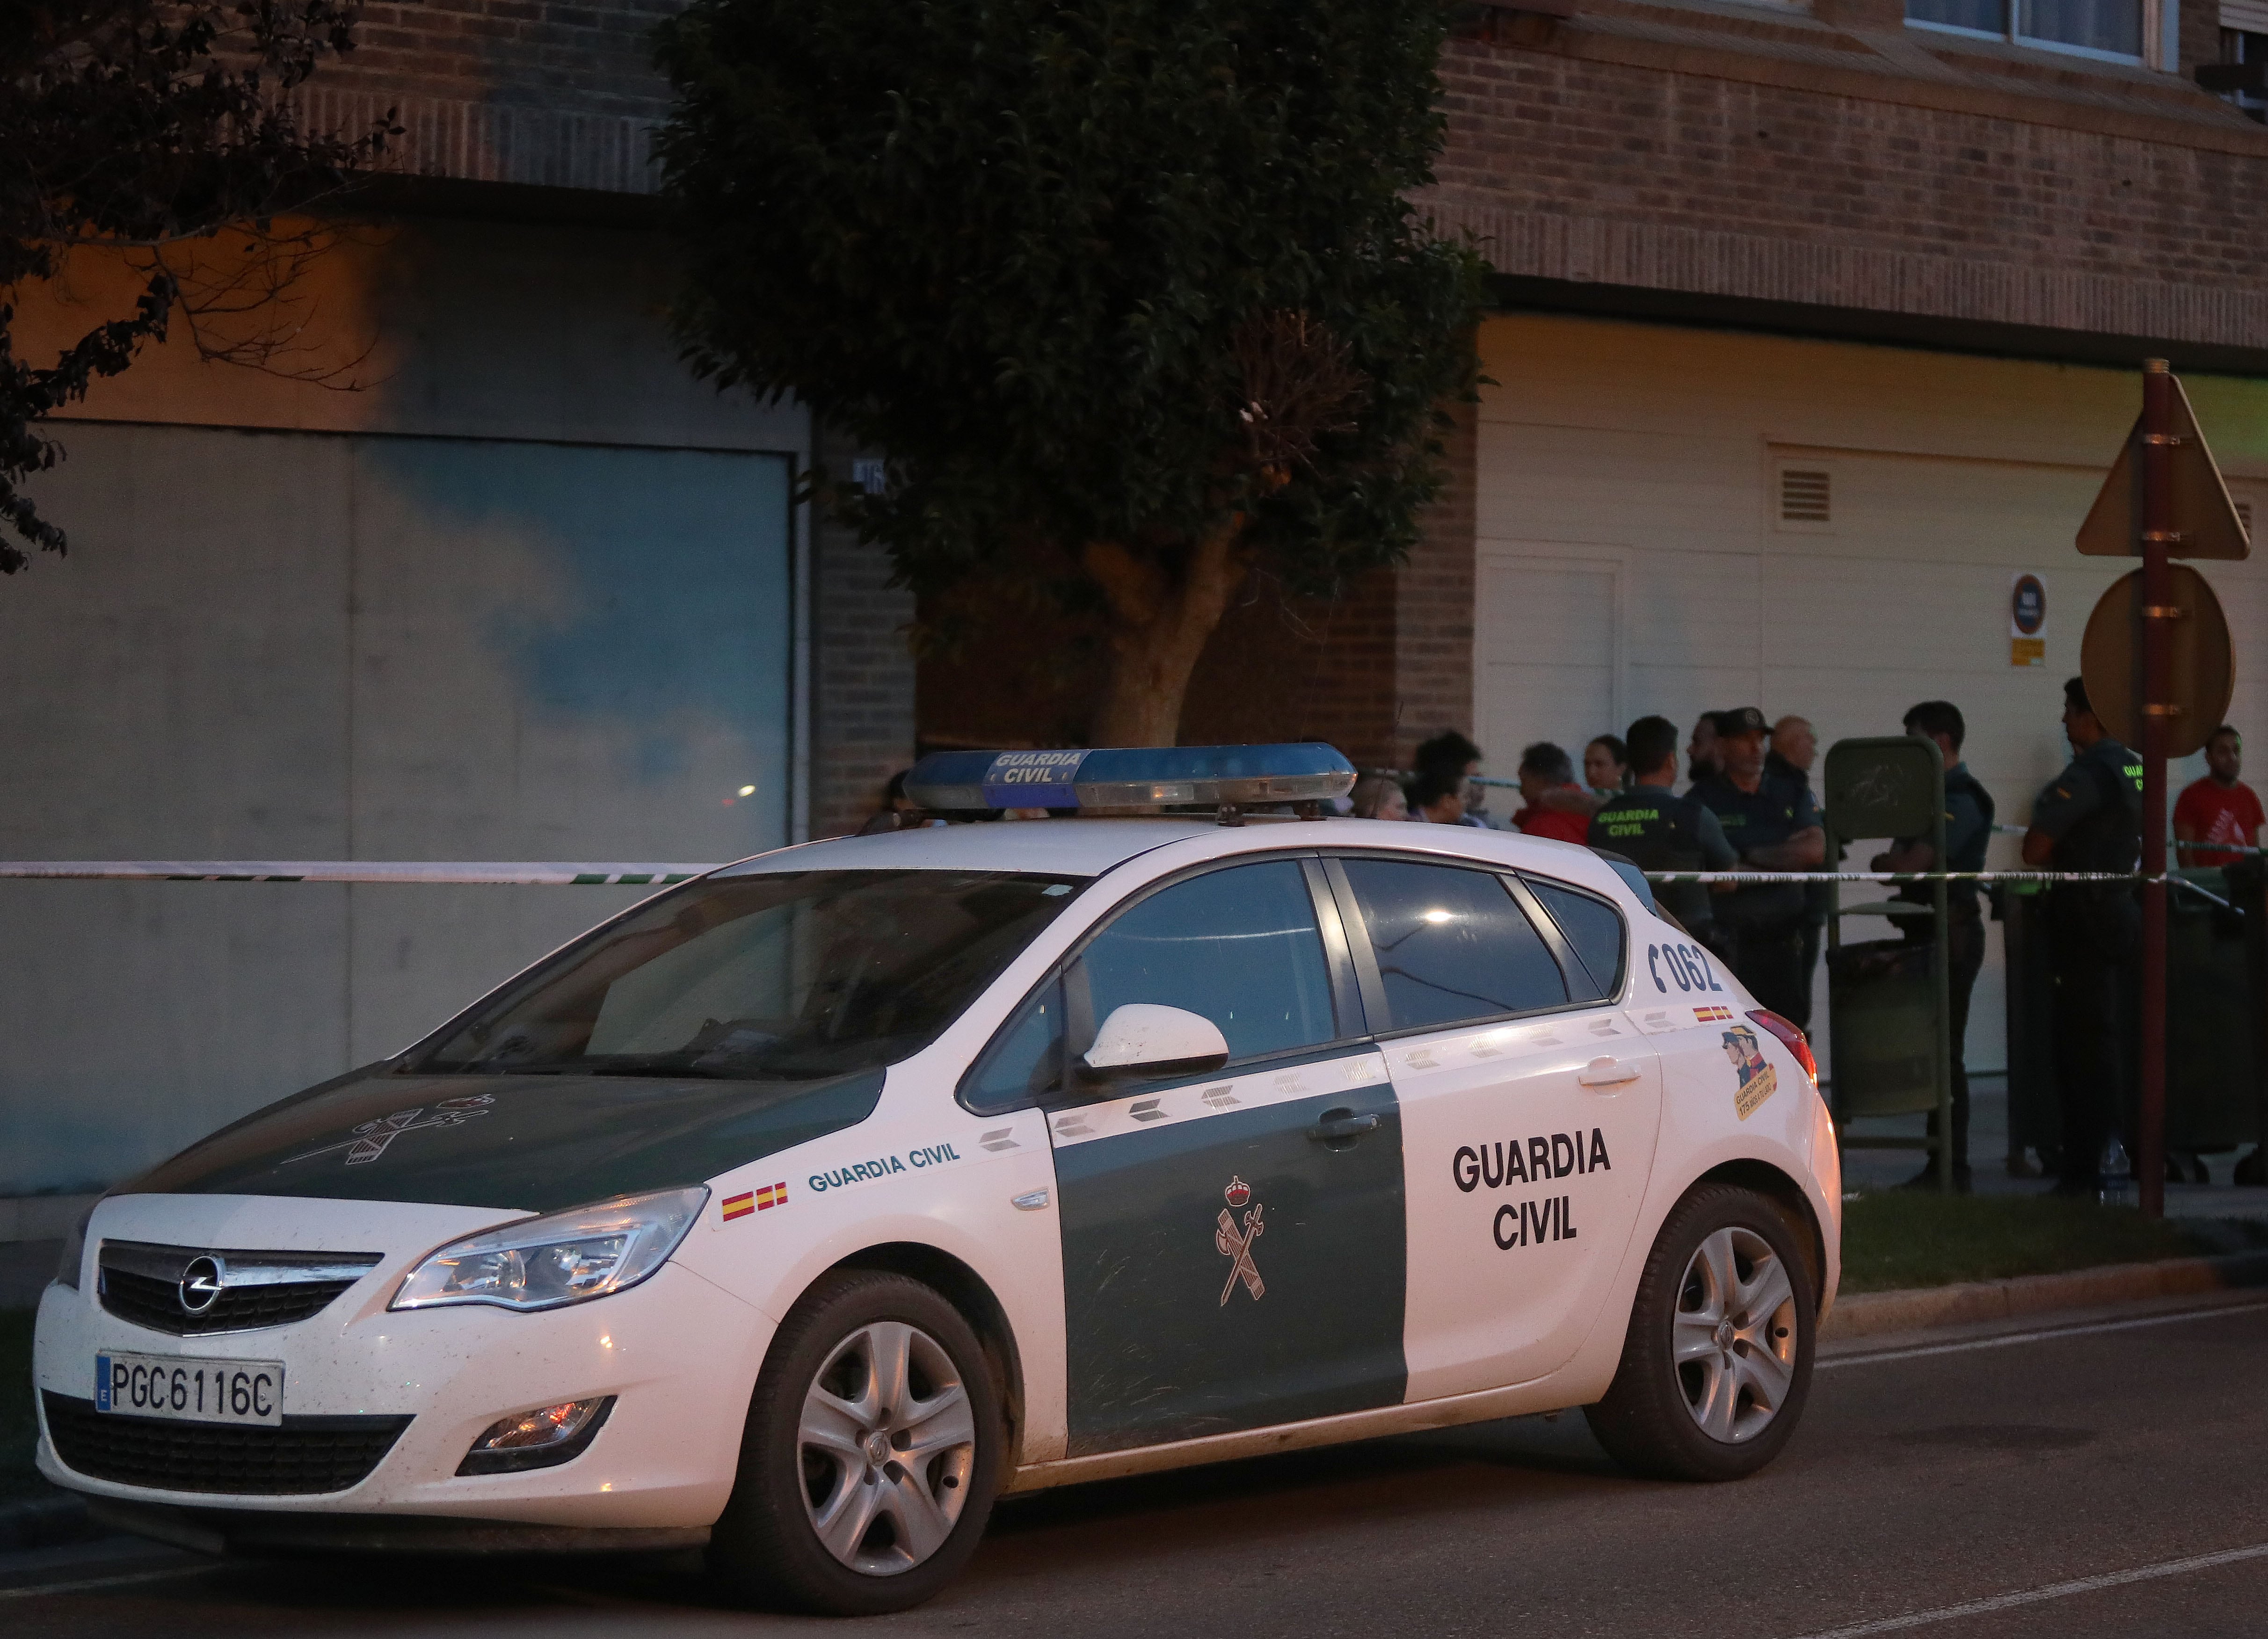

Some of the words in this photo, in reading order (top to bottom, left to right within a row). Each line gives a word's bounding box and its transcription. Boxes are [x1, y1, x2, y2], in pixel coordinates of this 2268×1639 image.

[996, 753, 1081, 766] GUARDIA
[1004, 767, 1053, 783] CIVIL
[1597, 808, 1659, 823] GUARDIA
[1608, 823, 1645, 836] CIVIL
[1662, 943, 1723, 992] 062
[1736, 1081, 1758, 1104] GUARDIA
[1758, 1071, 1770, 1085] CIVIL
[1739, 1101, 1750, 1116] 175
[808, 1155, 905, 1192] GUARDIA
[909, 1143, 960, 1168] CIVIL
[1453, 1128, 1611, 1192] GUARDIA
[1493, 1196, 1577, 1250] CIVIL
[100, 1390, 108, 1402] E
[112, 1363, 273, 1417] PGC6116C
